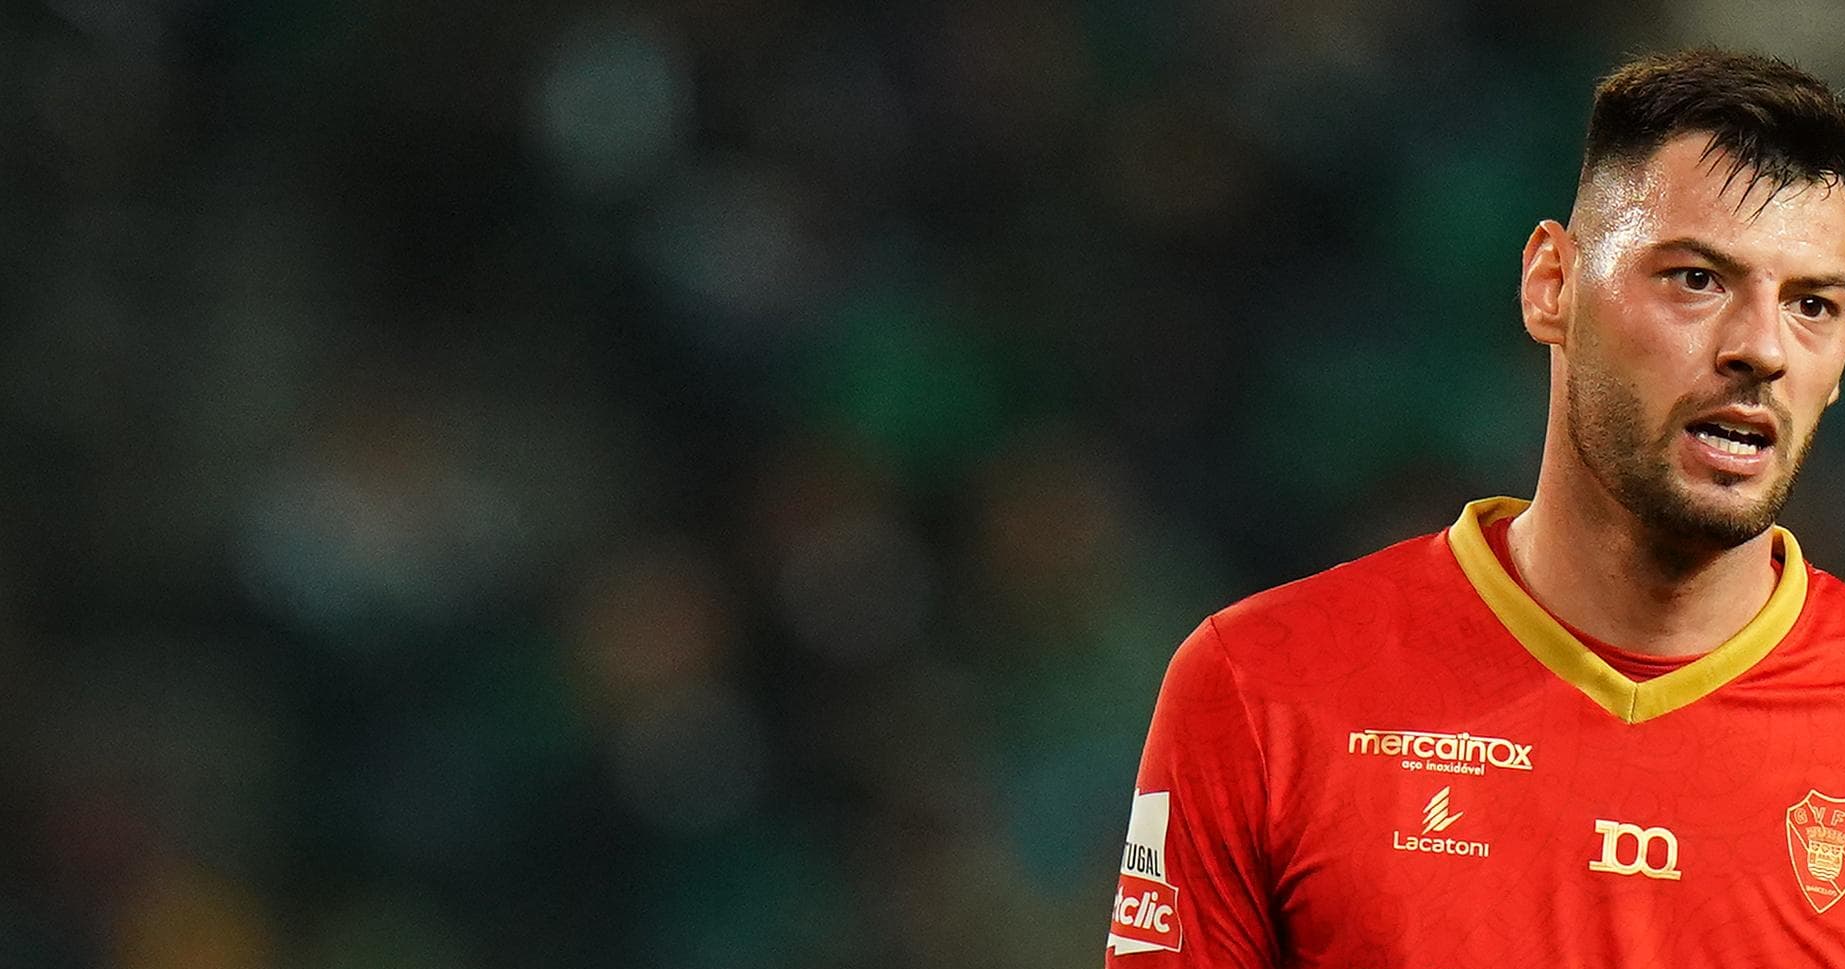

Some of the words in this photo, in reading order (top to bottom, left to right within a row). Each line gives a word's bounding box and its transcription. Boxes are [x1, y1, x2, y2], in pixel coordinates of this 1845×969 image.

[1402, 760, 1422, 772] aço
[1426, 760, 1485, 776] inoxidável
[1393, 831, 1489, 857] Lacatoni
[1112, 886, 1174, 933] tclic
